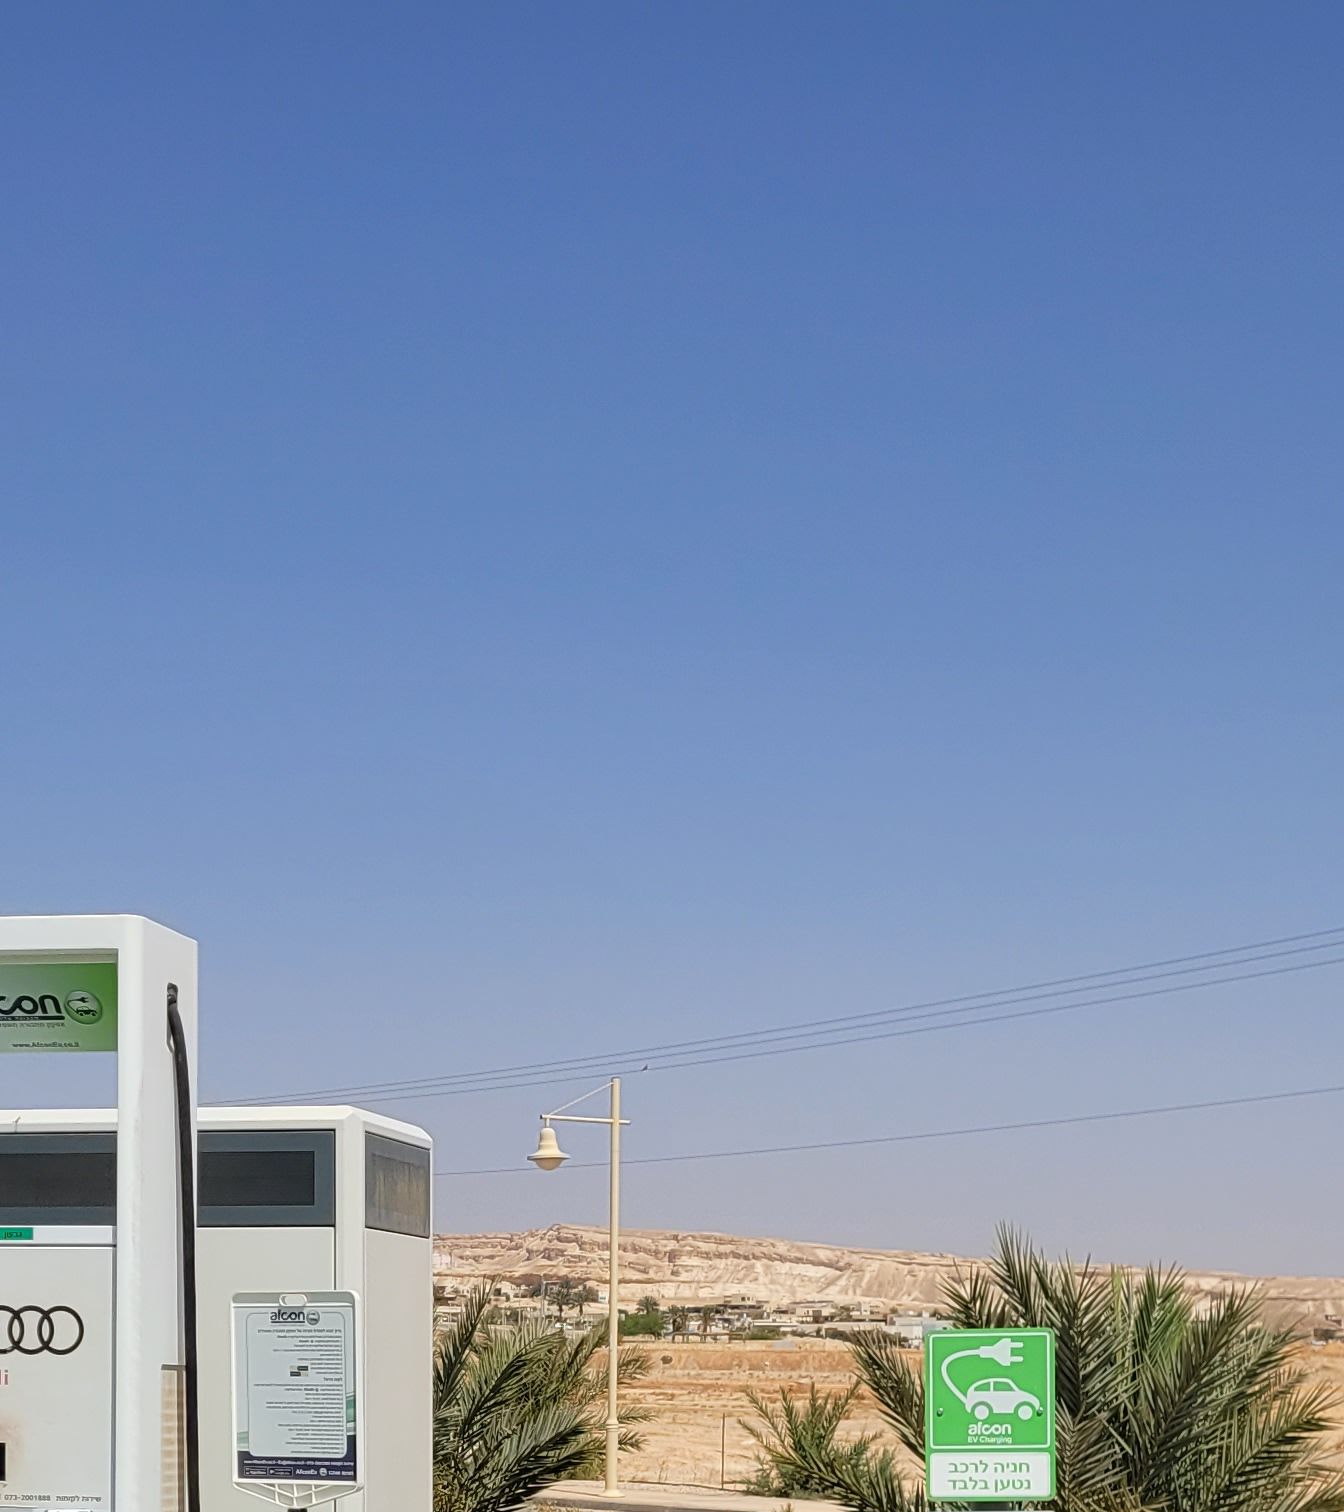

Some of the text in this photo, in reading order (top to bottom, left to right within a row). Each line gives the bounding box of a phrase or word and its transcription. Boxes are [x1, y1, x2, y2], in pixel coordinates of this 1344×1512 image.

[270, 1308, 306, 1321] afcon
[968, 1421, 1012, 1435] afcon
[979, 1436, 1013, 1444] Charging
[948, 1460, 1030, 1473] חניה לרכב
[947, 1476, 1031, 1493] נטען בלבד
